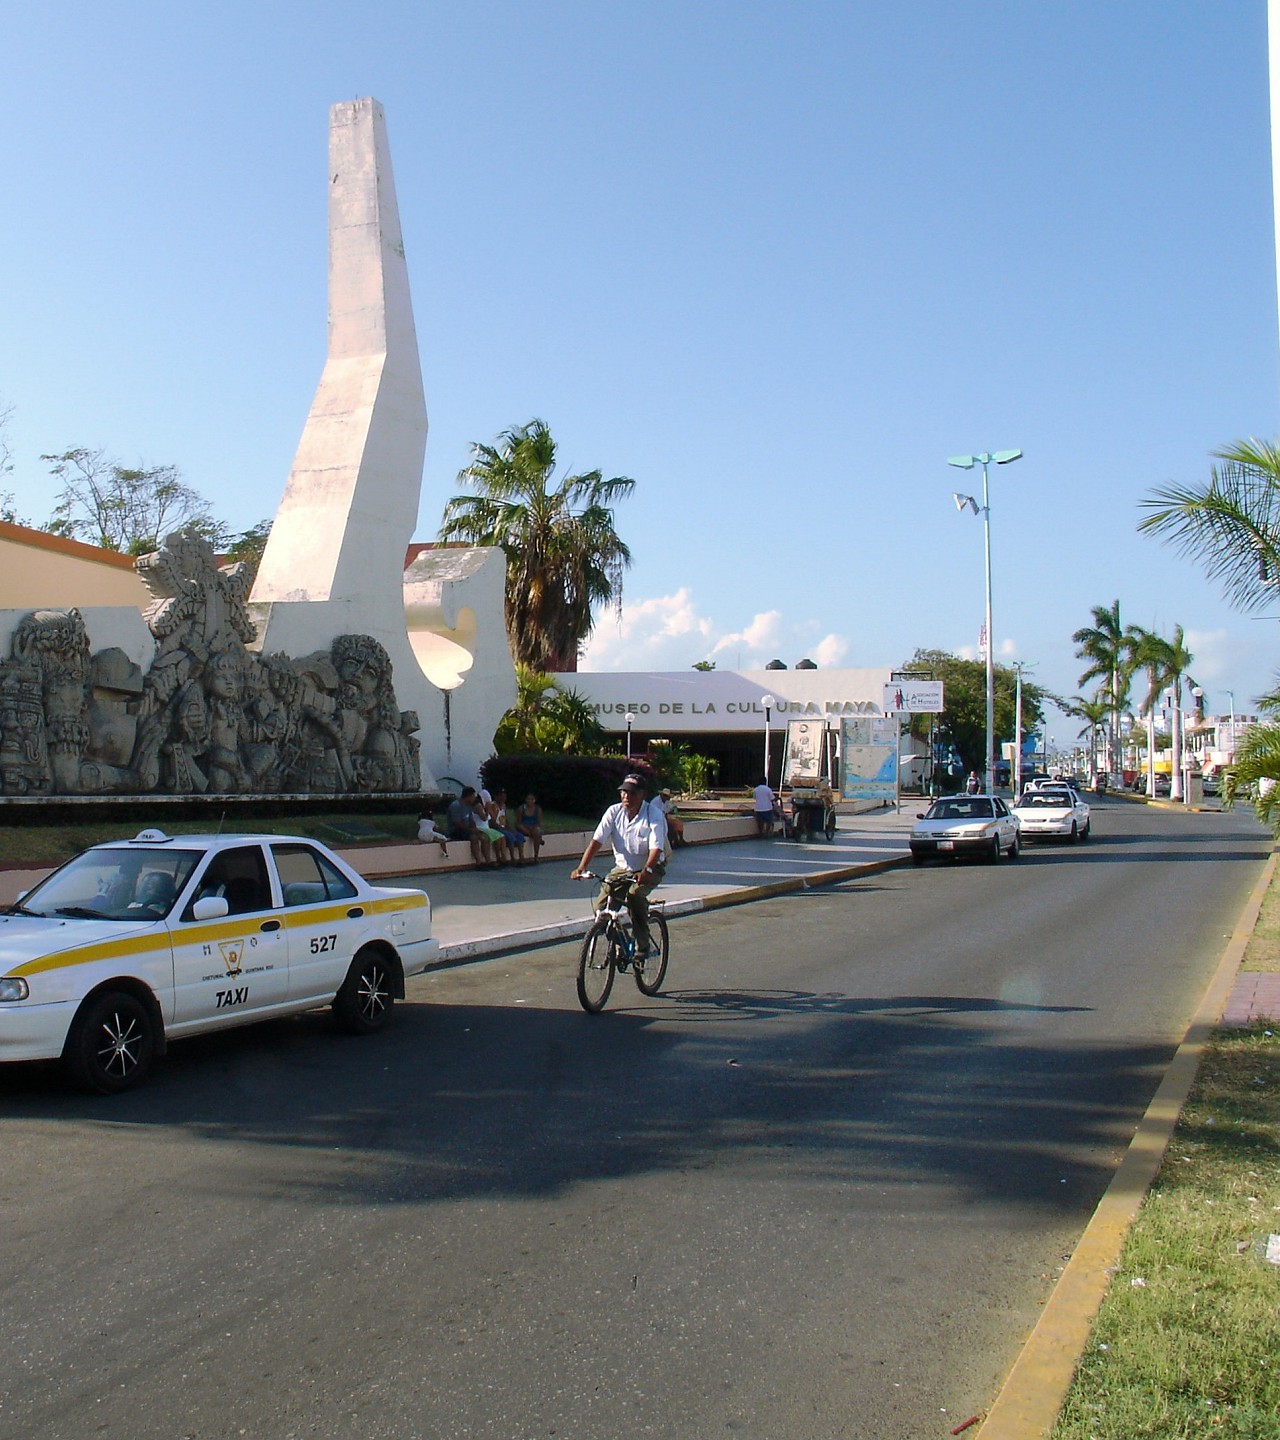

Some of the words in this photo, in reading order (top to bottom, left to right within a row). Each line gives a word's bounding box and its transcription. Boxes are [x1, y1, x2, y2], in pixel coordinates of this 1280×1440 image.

[587, 702, 651, 714] MUSEO
[659, 702, 684, 714] DE
[691, 702, 716, 714] LA
[726, 701, 816, 714] CULURA
[825, 701, 874, 714] MAYA
[310, 934, 337, 954] 527
[215, 986, 249, 1009] TAXI
